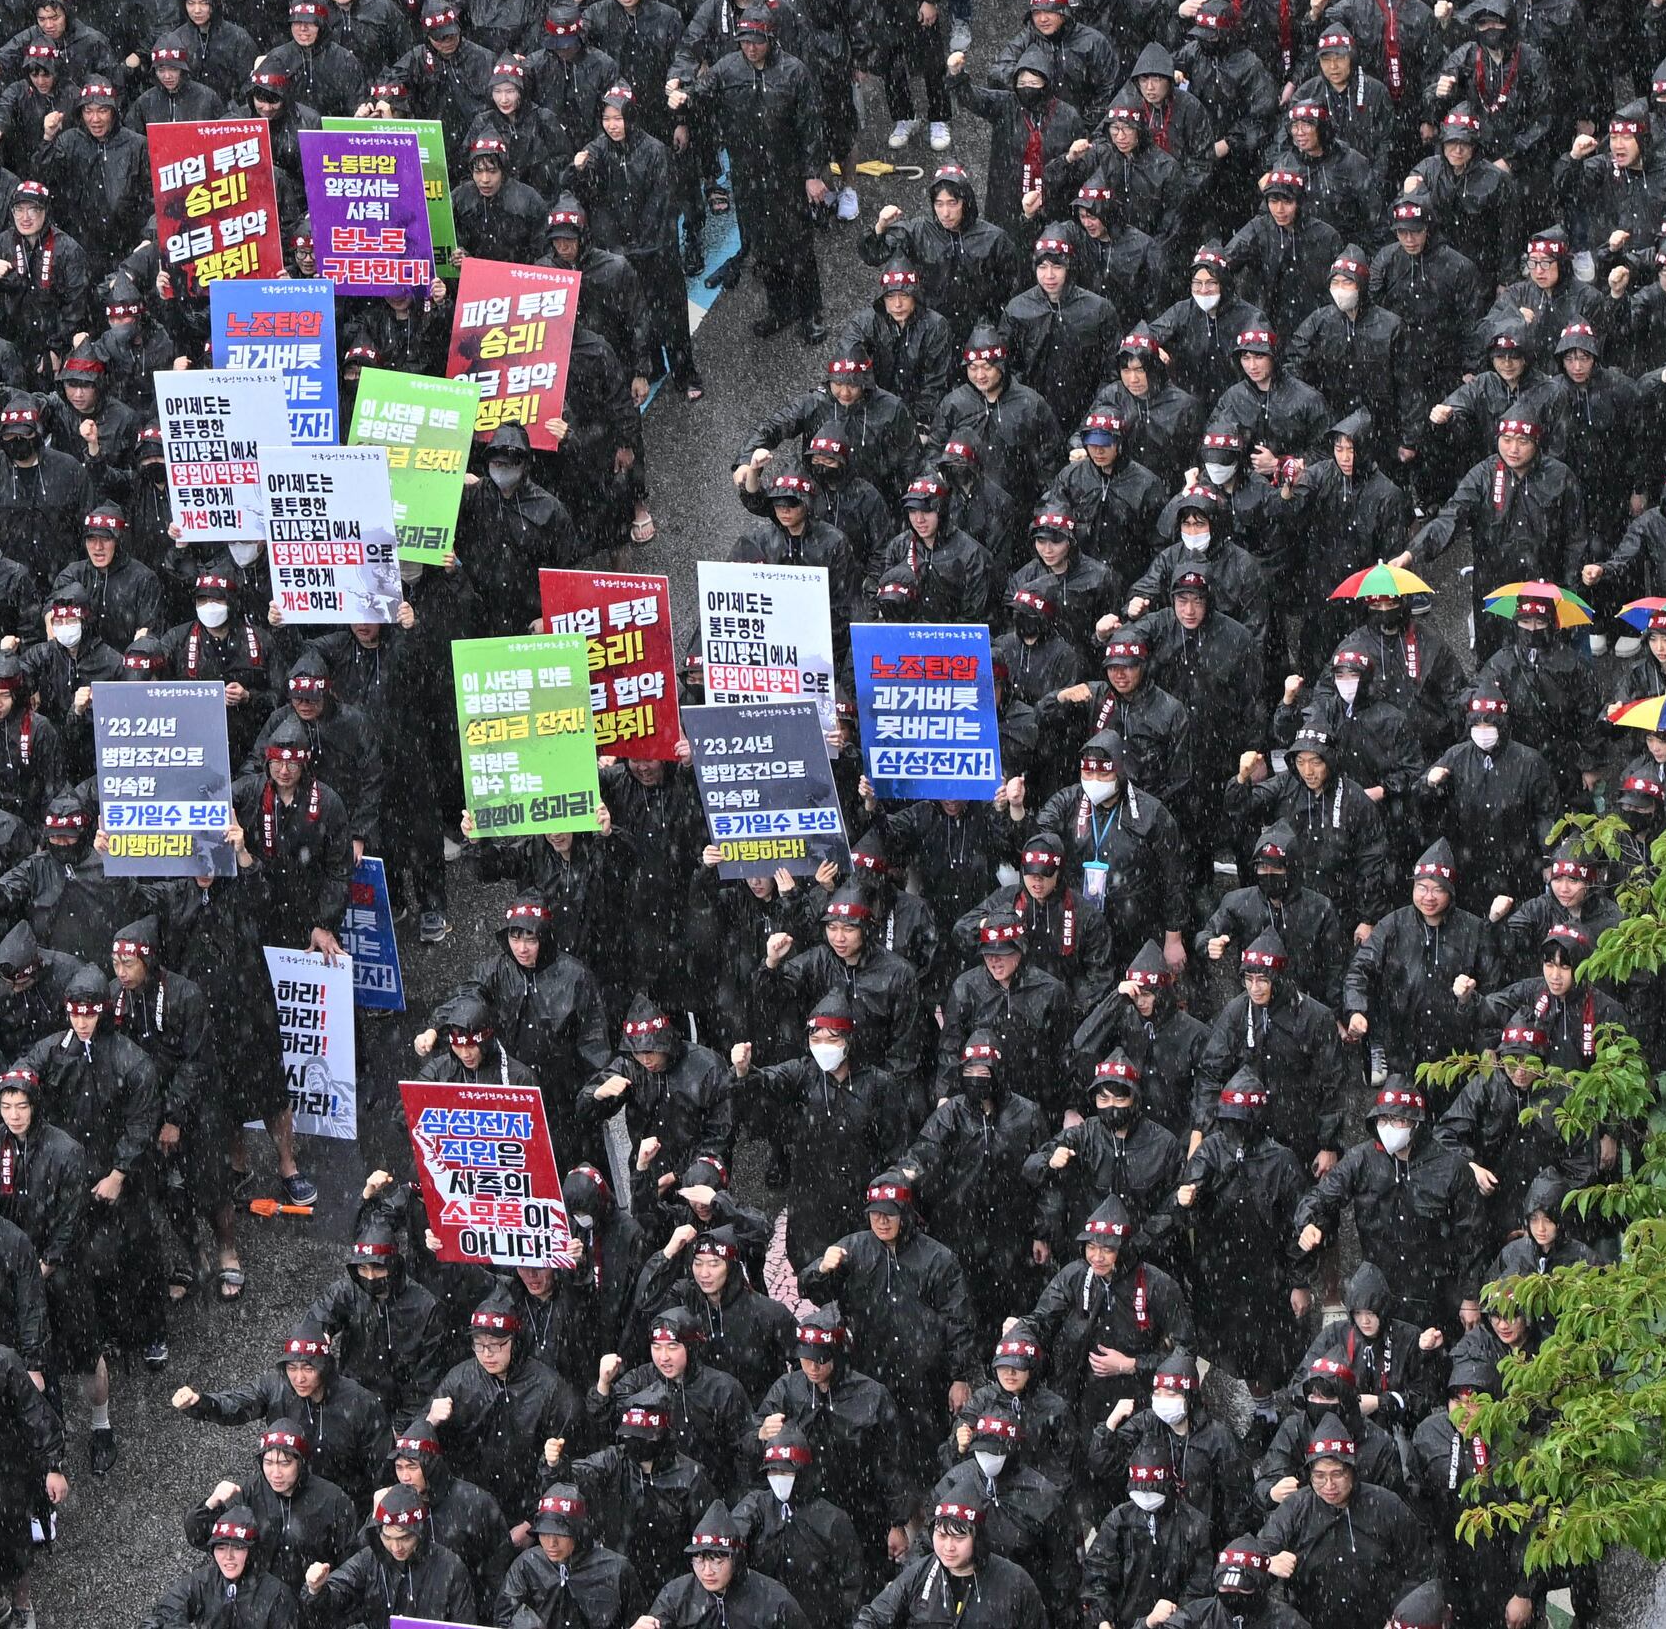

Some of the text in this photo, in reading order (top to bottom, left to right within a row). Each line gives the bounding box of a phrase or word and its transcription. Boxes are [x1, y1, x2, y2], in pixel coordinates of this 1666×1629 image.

[158, 137, 261, 193] 파업 투쟁
[322, 155, 396, 175] 노동탄압
[185, 174, 247, 218] 승리!
[325, 177, 400, 198] 앞장서는
[346, 201, 390, 221] 사측!
[166, 208, 268, 263] 임금 협약
[331, 227, 406, 255] 분노로
[194, 242, 258, 287] 쟁취!
[322, 258, 430, 286] 규탄한다!
[460, 288, 568, 330] 파업 투쟁
[479, 323, 544, 360] 승리!
[473, 396, 539, 430] 쟁취!
[267, 473, 334, 494] OPI제도는
[271, 497, 327, 517] 불투명한
[271, 518, 361, 541] EVA방식 에서
[274, 543, 394, 565] 영업이익방식 으로
[279, 567, 335, 588] 투명하게
[282, 591, 343, 611] 개선하라!
[462, 667, 572, 691] 이 사단을 만든
[870, 655, 979, 679] 노조탄압
[463, 691, 531, 713] 경영진은
[872, 685, 980, 711] 과거버릇
[466, 707, 586, 745] 성과금 잔치!
[875, 715, 982, 741] 못버리는
[102, 746, 204, 769] 병합조건으로
[469, 751, 520, 772] 직원은
[700, 760, 806, 781] 병합조건으로
[875, 751, 992, 777] 삼성전자!
[103, 776, 157, 798] 약속한
[471, 772, 543, 795] 알수 없는
[474, 790, 595, 829] 깜깜이 성과금!
[706, 788, 760, 808] 약속한
[107, 802, 228, 830] 휴가일수 보상
[713, 809, 838, 836] 휴가일수 보상
[109, 834, 193, 859] 이행하라!
[719, 838, 807, 862] 이행하라!
[420, 1108, 533, 1140] 삼성전자
[441, 1140, 525, 1169] 직원은
[449, 1171, 531, 1199] 사측의
[441, 1202, 551, 1229] 소모품이
[460, 1230, 552, 1259] 아니다!
